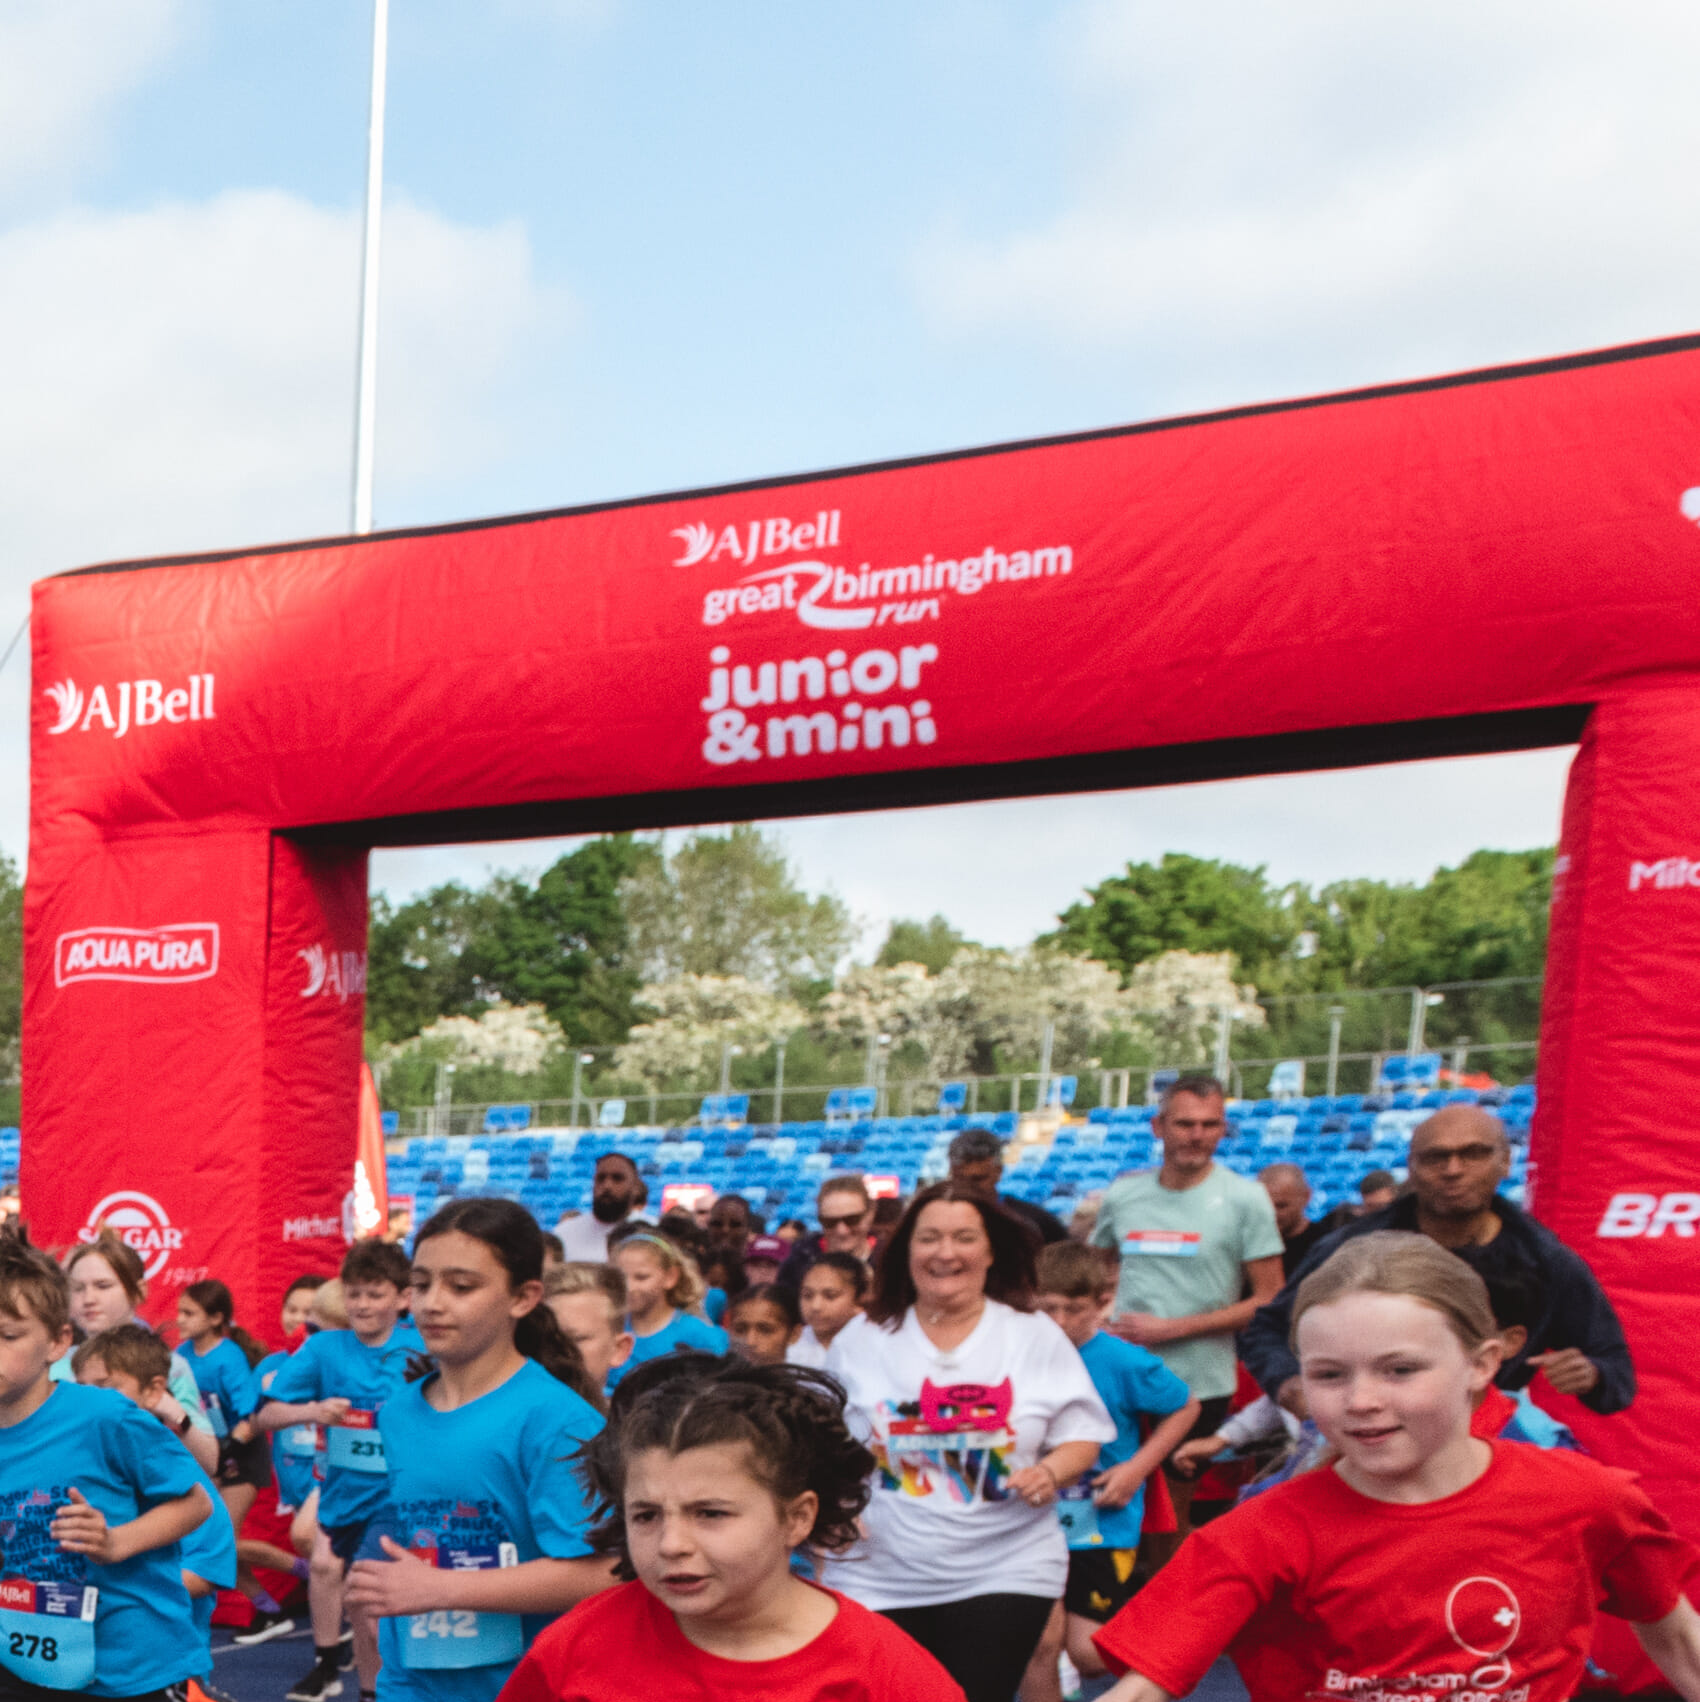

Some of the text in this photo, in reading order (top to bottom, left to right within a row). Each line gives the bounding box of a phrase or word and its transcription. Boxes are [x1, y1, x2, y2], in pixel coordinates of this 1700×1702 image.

[710, 509, 841, 567] AJBell
[703, 545, 1073, 626] great birmingham
[874, 596, 940, 627] run
[701, 643, 939, 712] junior
[79, 673, 217, 739] AJBell
[65, 937, 207, 972] AQUA PURA
[9, 1631, 58, 1663] 278
[410, 1610, 479, 1639] 242
